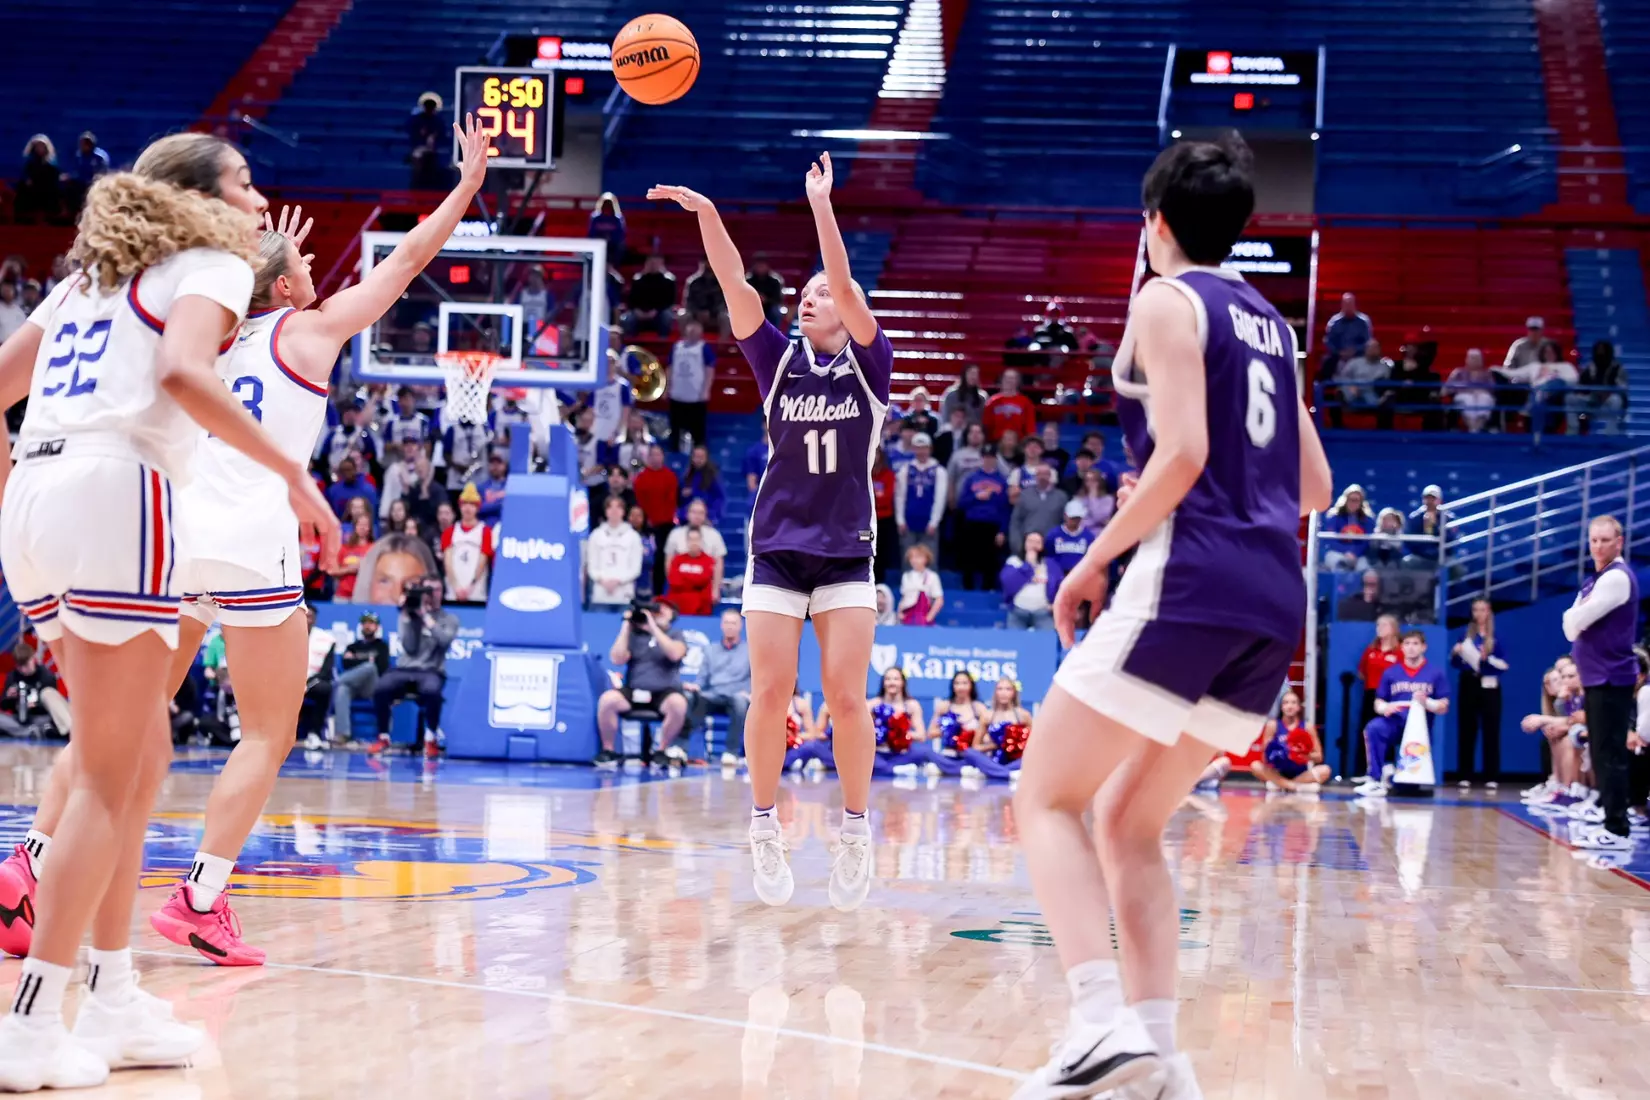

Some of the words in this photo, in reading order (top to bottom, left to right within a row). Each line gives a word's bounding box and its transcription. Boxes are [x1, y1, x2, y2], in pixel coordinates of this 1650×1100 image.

[616, 46, 670, 69] Wilson
[483, 77, 544, 108] 6:50
[477, 107, 534, 156] 24
[1228, 303, 1284, 357] GARCIA
[43, 319, 113, 397] 22
[780, 392, 861, 422] Wildcats
[1245, 358, 1277, 448] 6
[803, 428, 837, 474] 11
[902, 652, 1018, 682] Kansas
